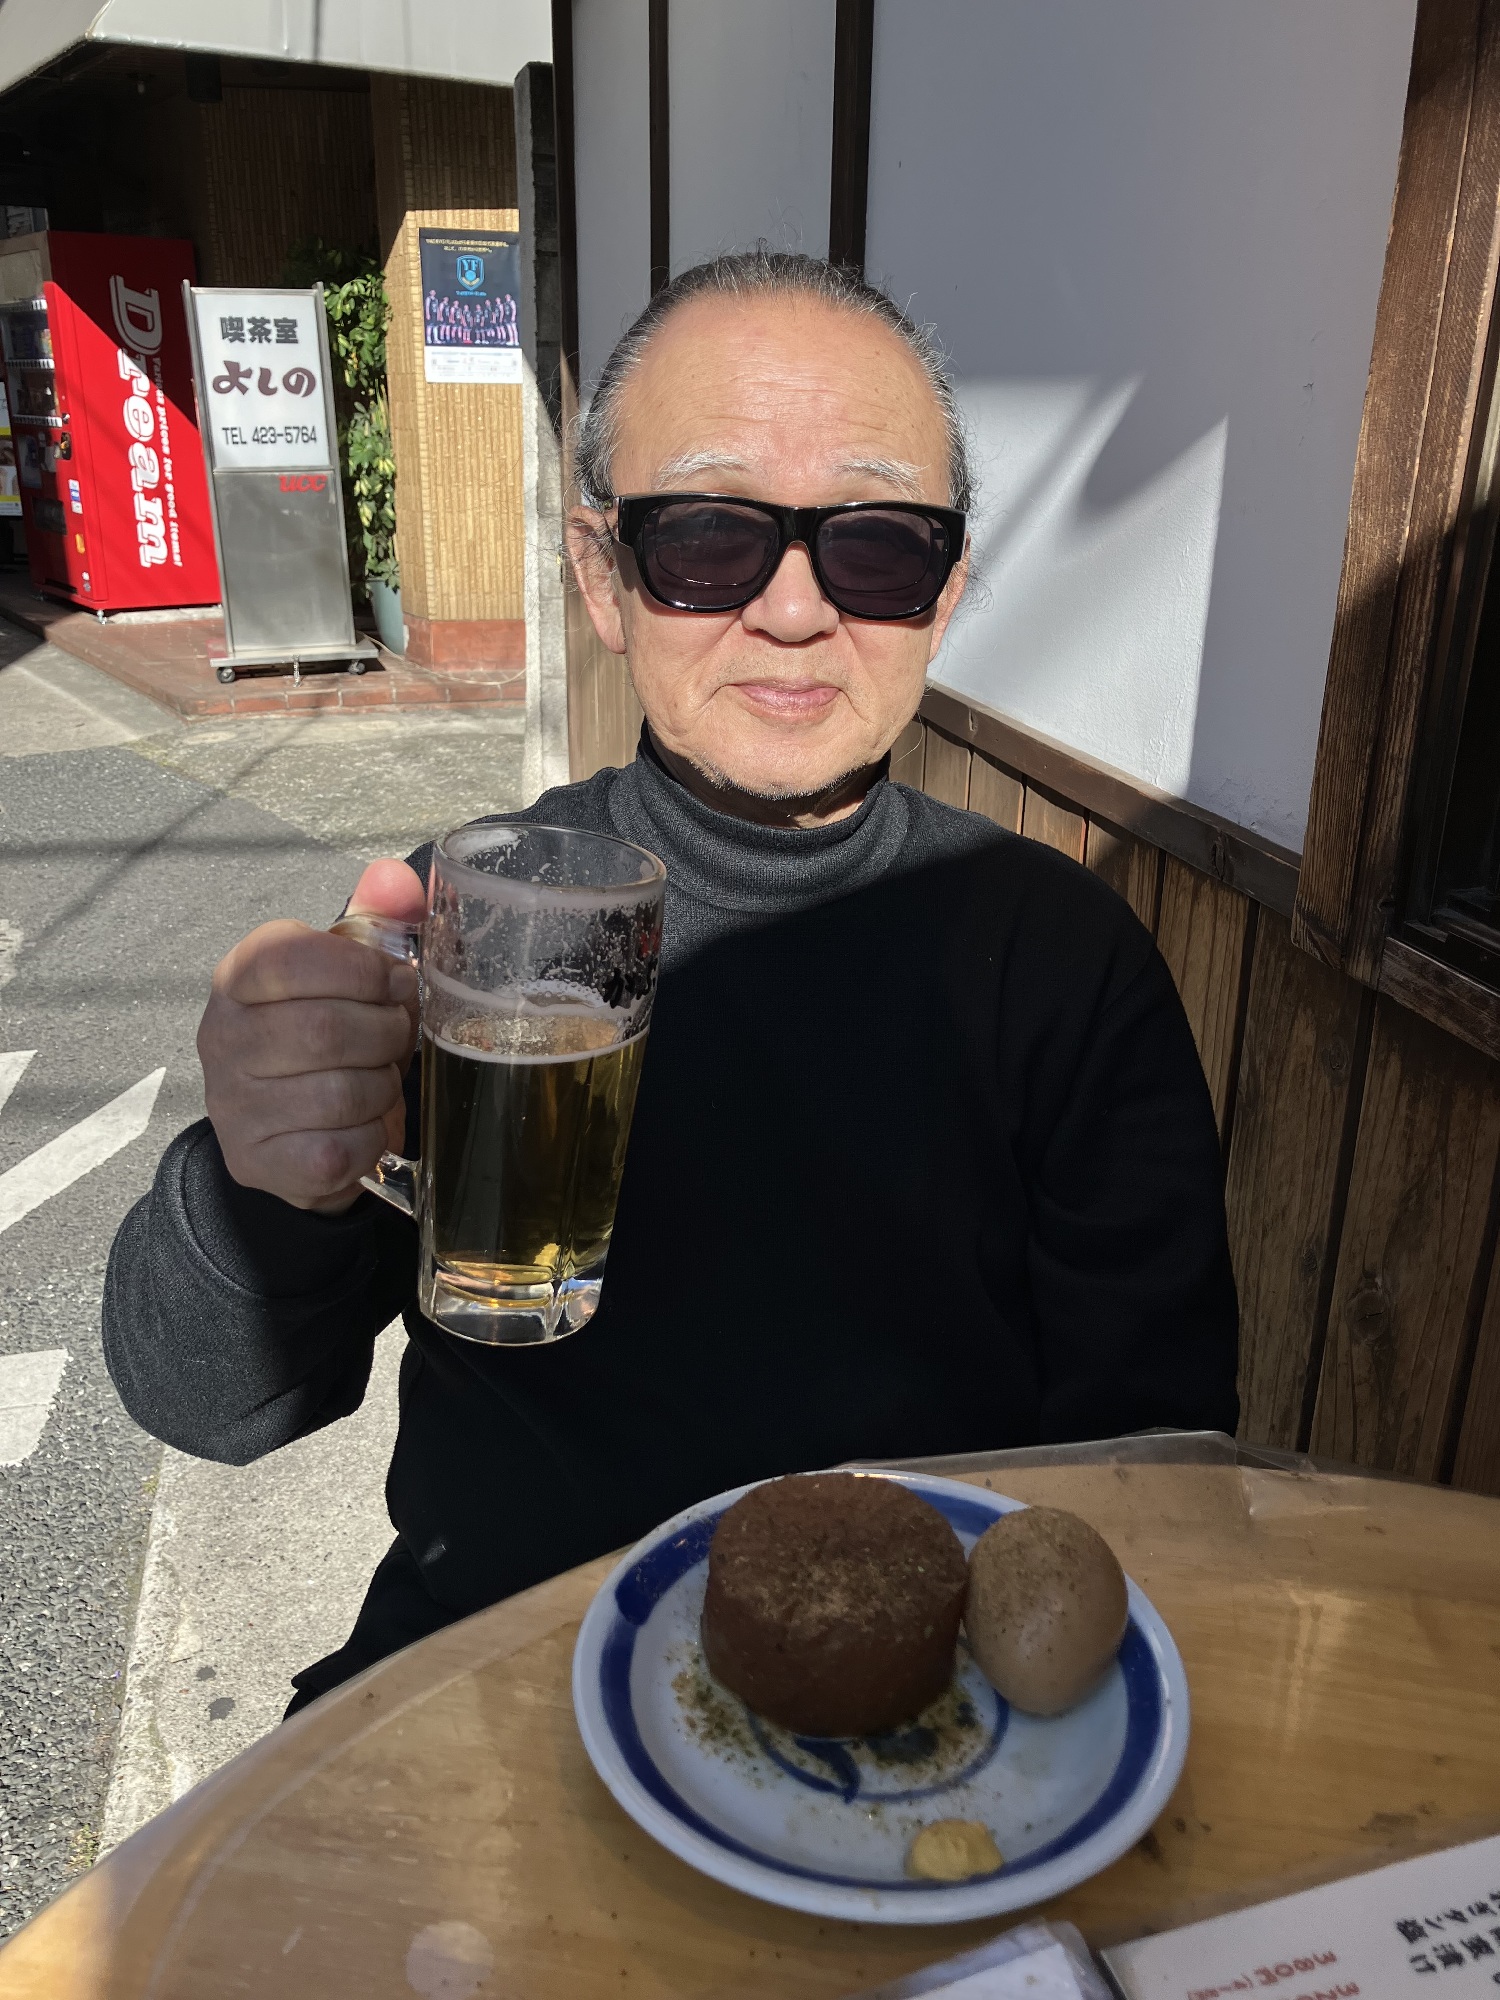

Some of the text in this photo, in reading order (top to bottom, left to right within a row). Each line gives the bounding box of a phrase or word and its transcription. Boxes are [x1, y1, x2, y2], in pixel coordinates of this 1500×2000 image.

[219, 316, 300, 344] 喫茶室
[212, 360, 317, 398] よしの
[109, 275, 168, 567] Dream
[222, 425, 317, 445] TEL 423-5764
[163, 457, 173, 480] for
[164, 483, 177, 518] good
